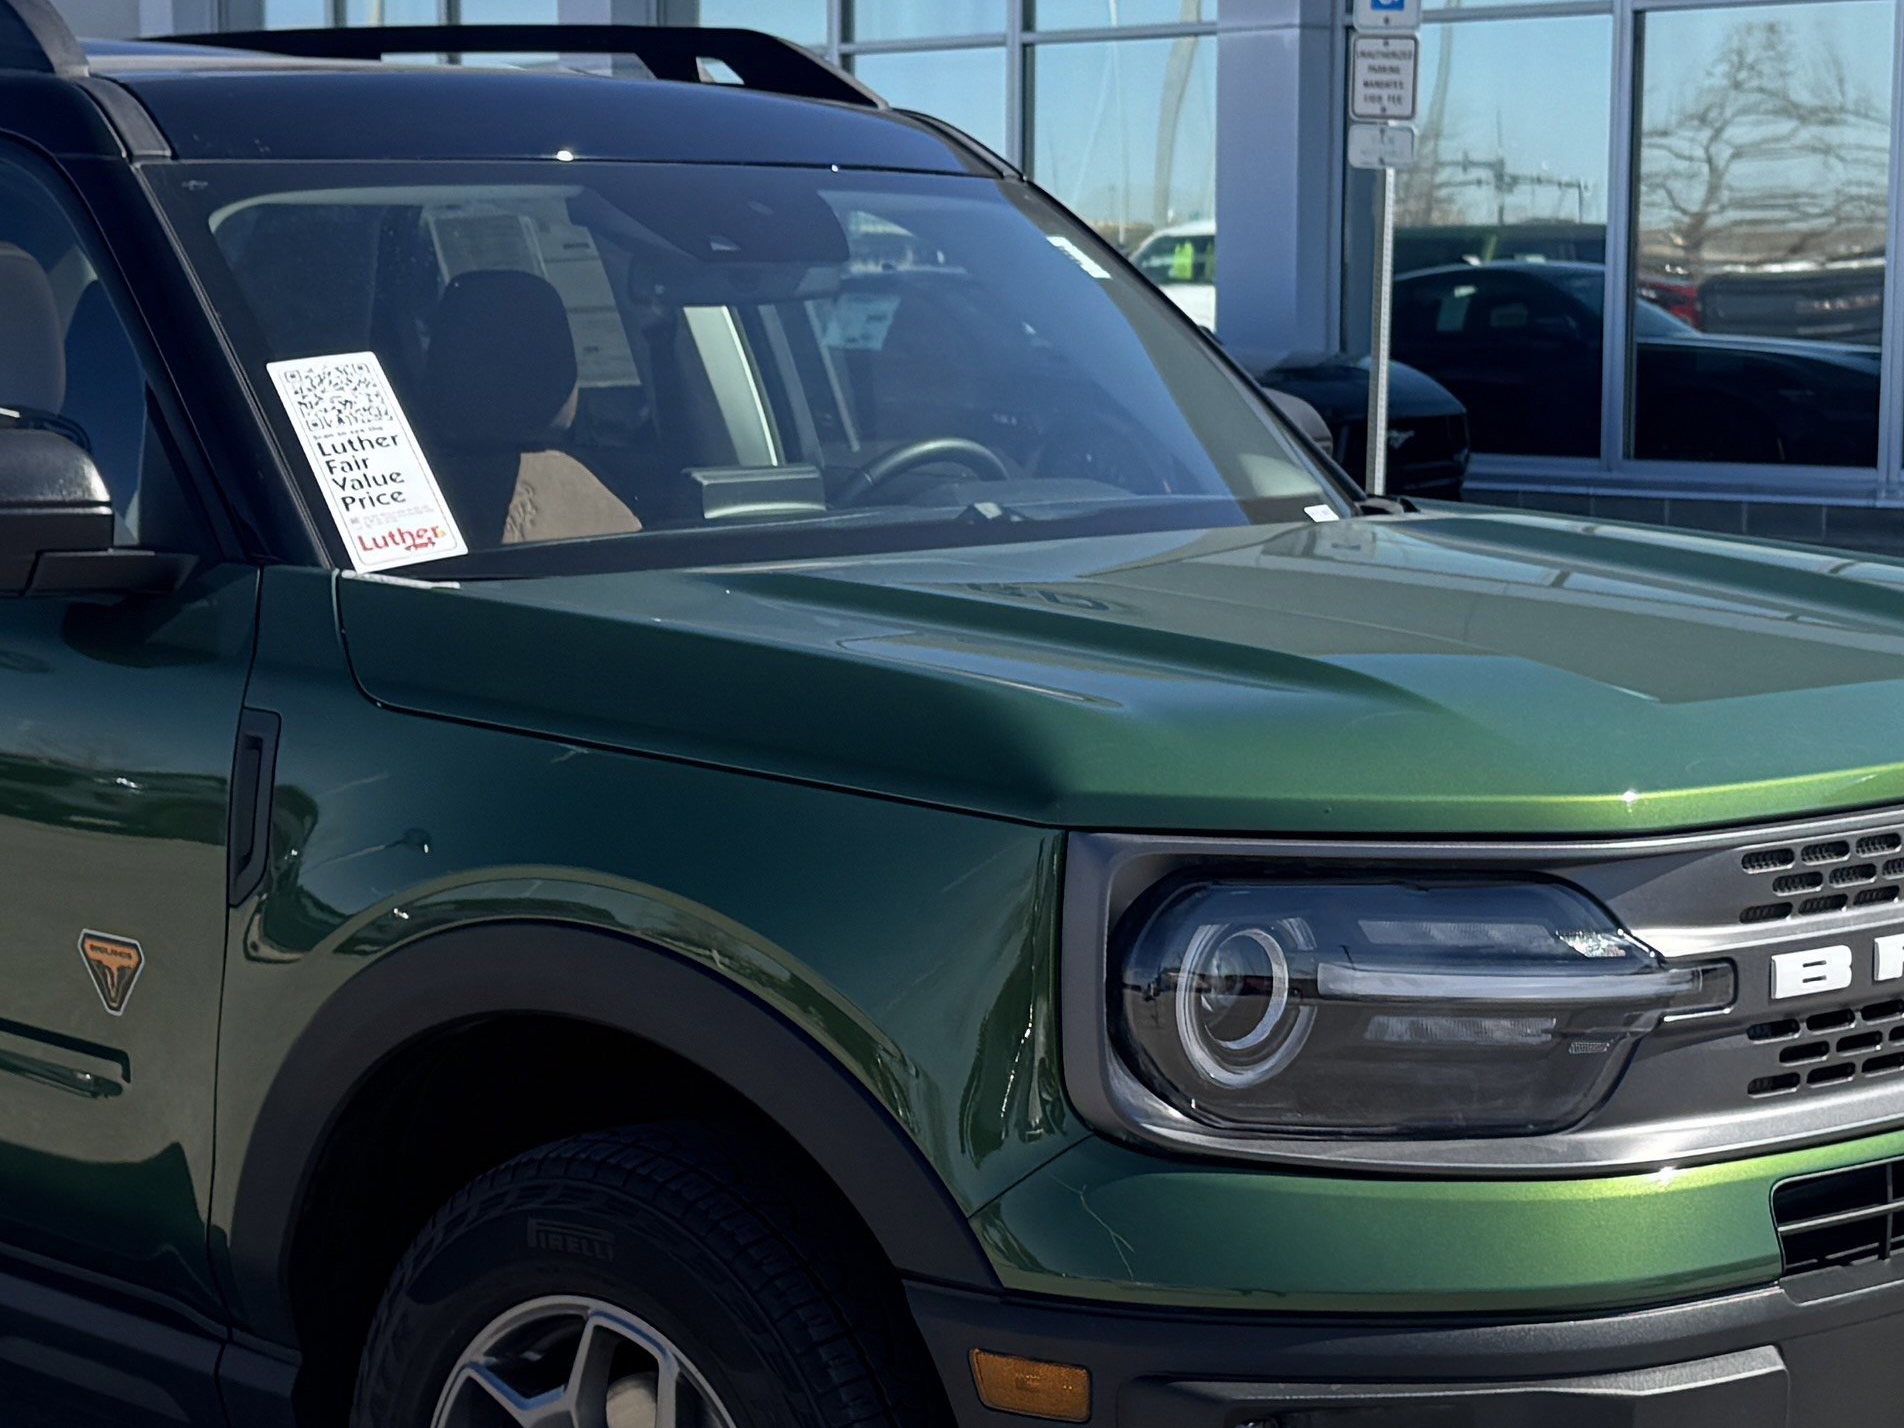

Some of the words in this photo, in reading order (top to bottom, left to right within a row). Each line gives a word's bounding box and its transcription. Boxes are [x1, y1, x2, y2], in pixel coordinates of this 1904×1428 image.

[317, 433, 399, 457] Luther
[325, 455, 370, 476] Fair
[332, 471, 406, 492] Value
[341, 490, 407, 513] Price
[357, 525, 440, 552] Luther
[527, 1216, 616, 1263] PIRELLI
